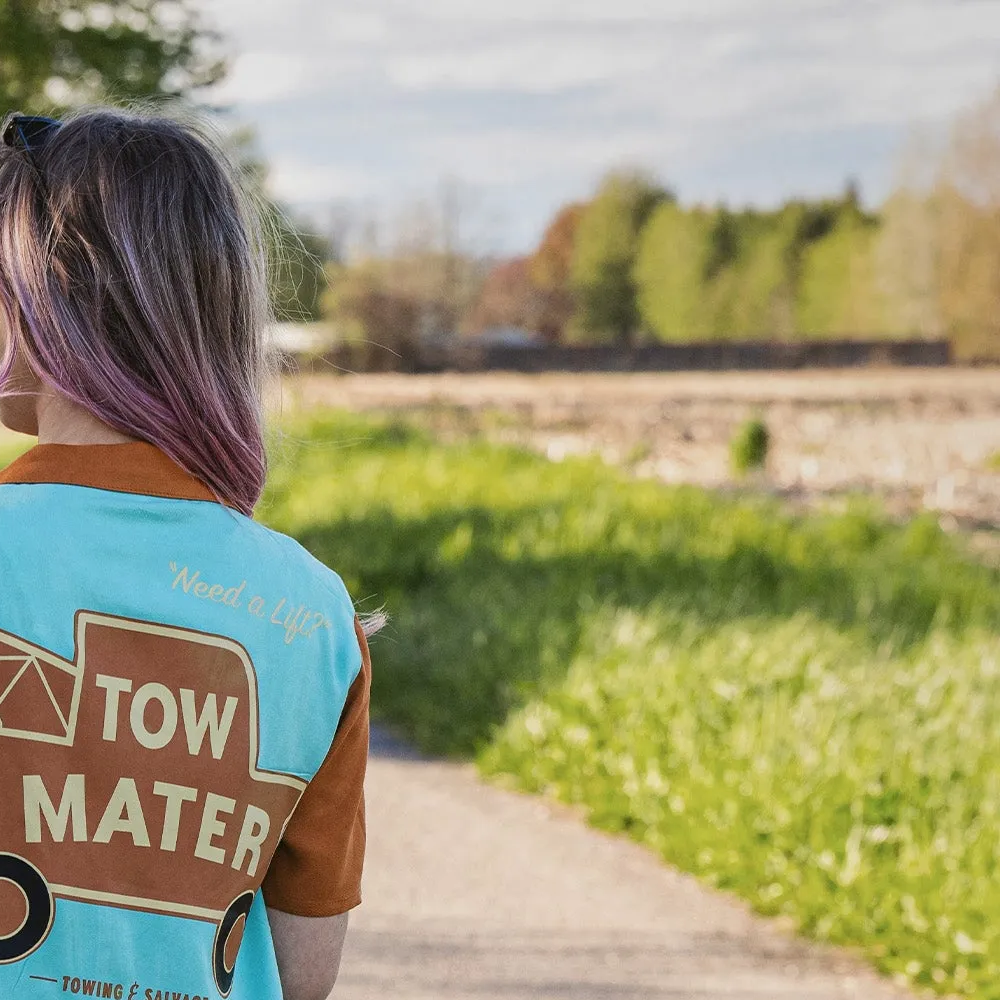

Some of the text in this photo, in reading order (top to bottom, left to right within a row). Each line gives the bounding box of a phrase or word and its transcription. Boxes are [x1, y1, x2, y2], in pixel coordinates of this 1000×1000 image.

[247, 595, 266, 617] a
[95, 673, 239, 760] TOW
[22, 773, 271, 878] MATER
[62, 975, 124, 1000] TOWING
